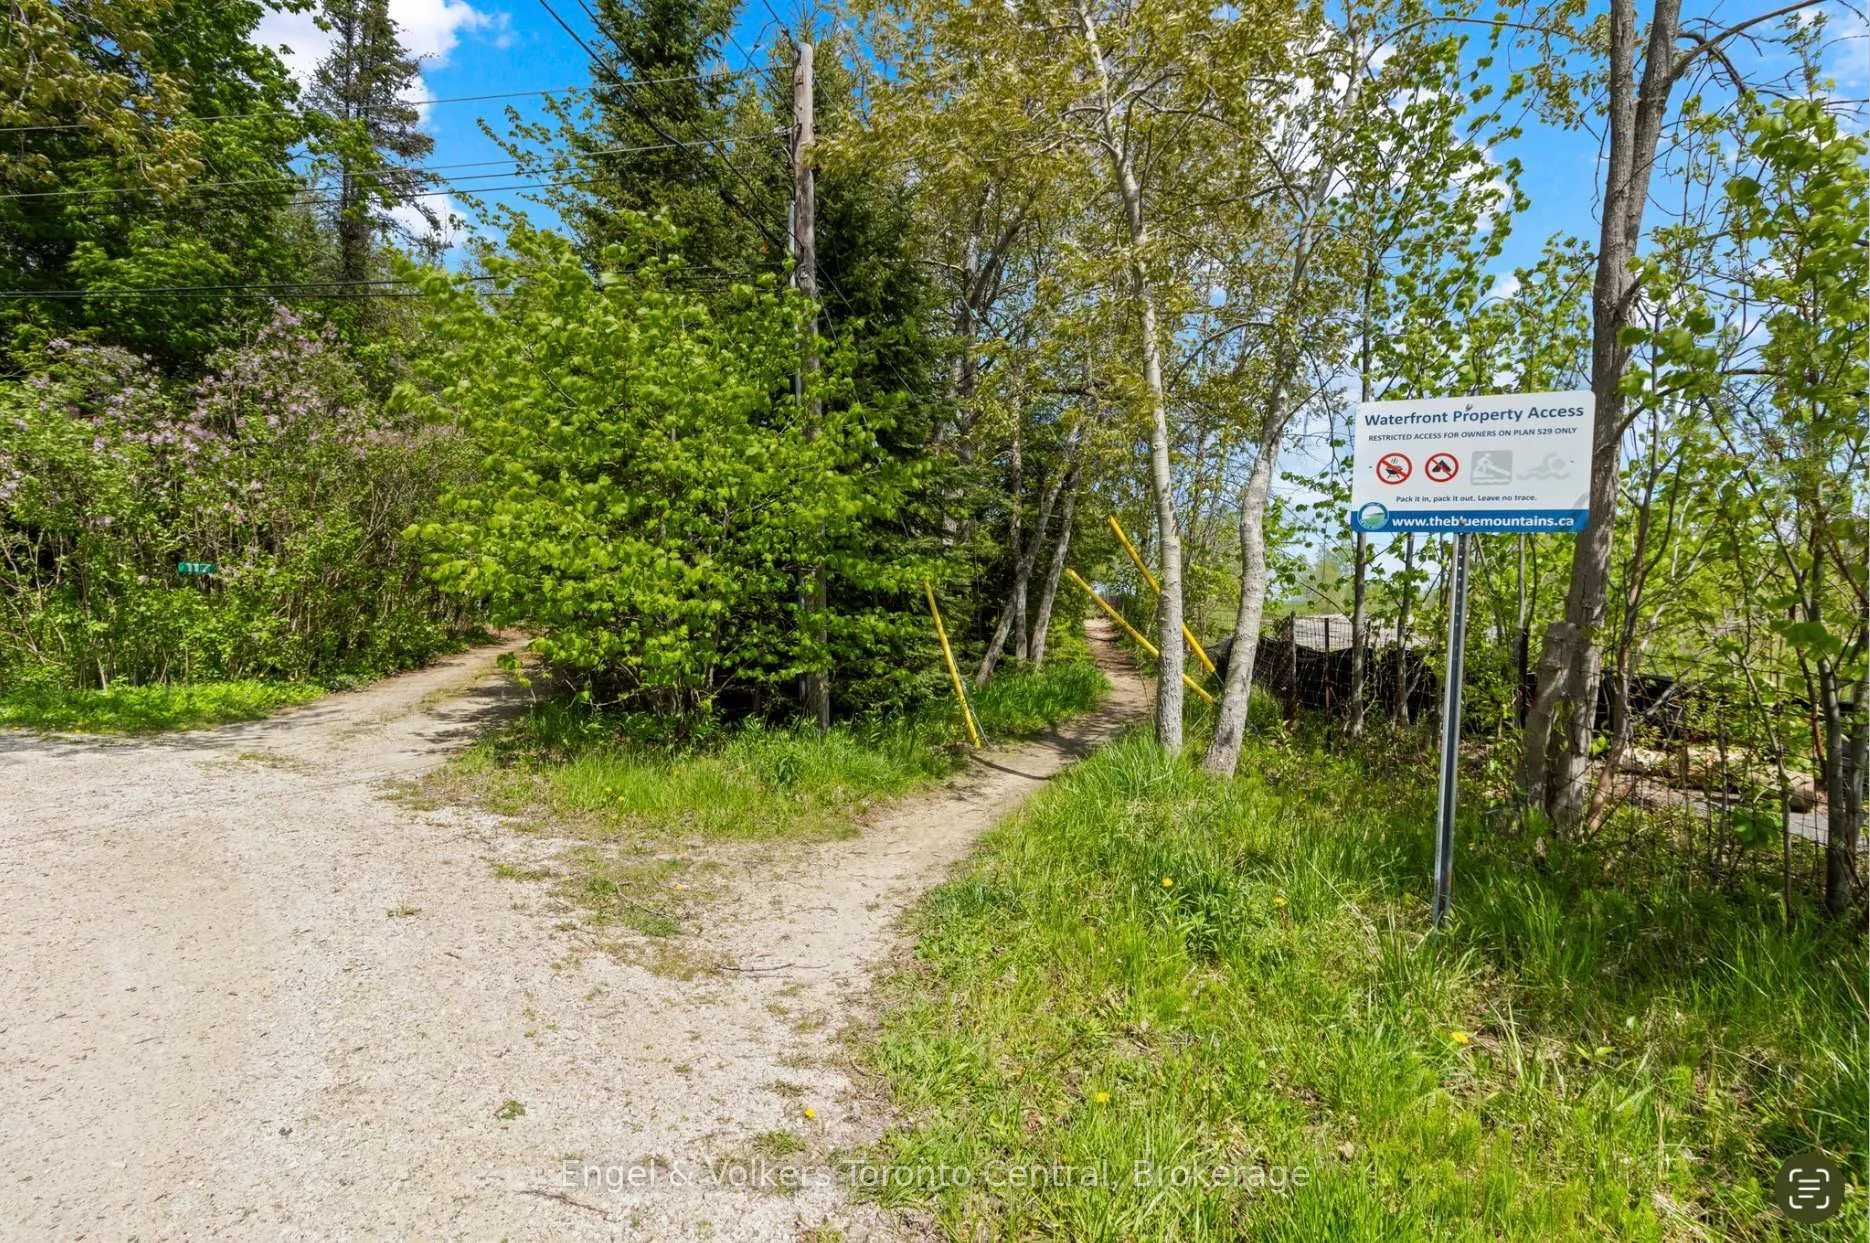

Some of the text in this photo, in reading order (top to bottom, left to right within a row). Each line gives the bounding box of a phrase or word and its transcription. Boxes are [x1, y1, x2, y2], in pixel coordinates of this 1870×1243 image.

[1364, 406, 1584, 426] Waterfront Property Access
[1368, 433, 1412, 442] RESTRICTED
[1413, 432, 1441, 440] ACCESS
[1443, 431, 1459, 439] FOR
[1460, 429, 1496, 438] OWNERS
[1513, 428, 1535, 436] PLAN
[1537, 427, 1553, 435] 529
[1554, 426, 1577, 434] ONLY
[1396, 495, 1414, 503] Pack
[1414, 495, 1421, 503] it
[1422, 495, 1432, 503] in,
[1433, 495, 1452, 503] pack
[1459, 494, 1476, 502] out.
[1478, 494, 1501, 502] Leave
